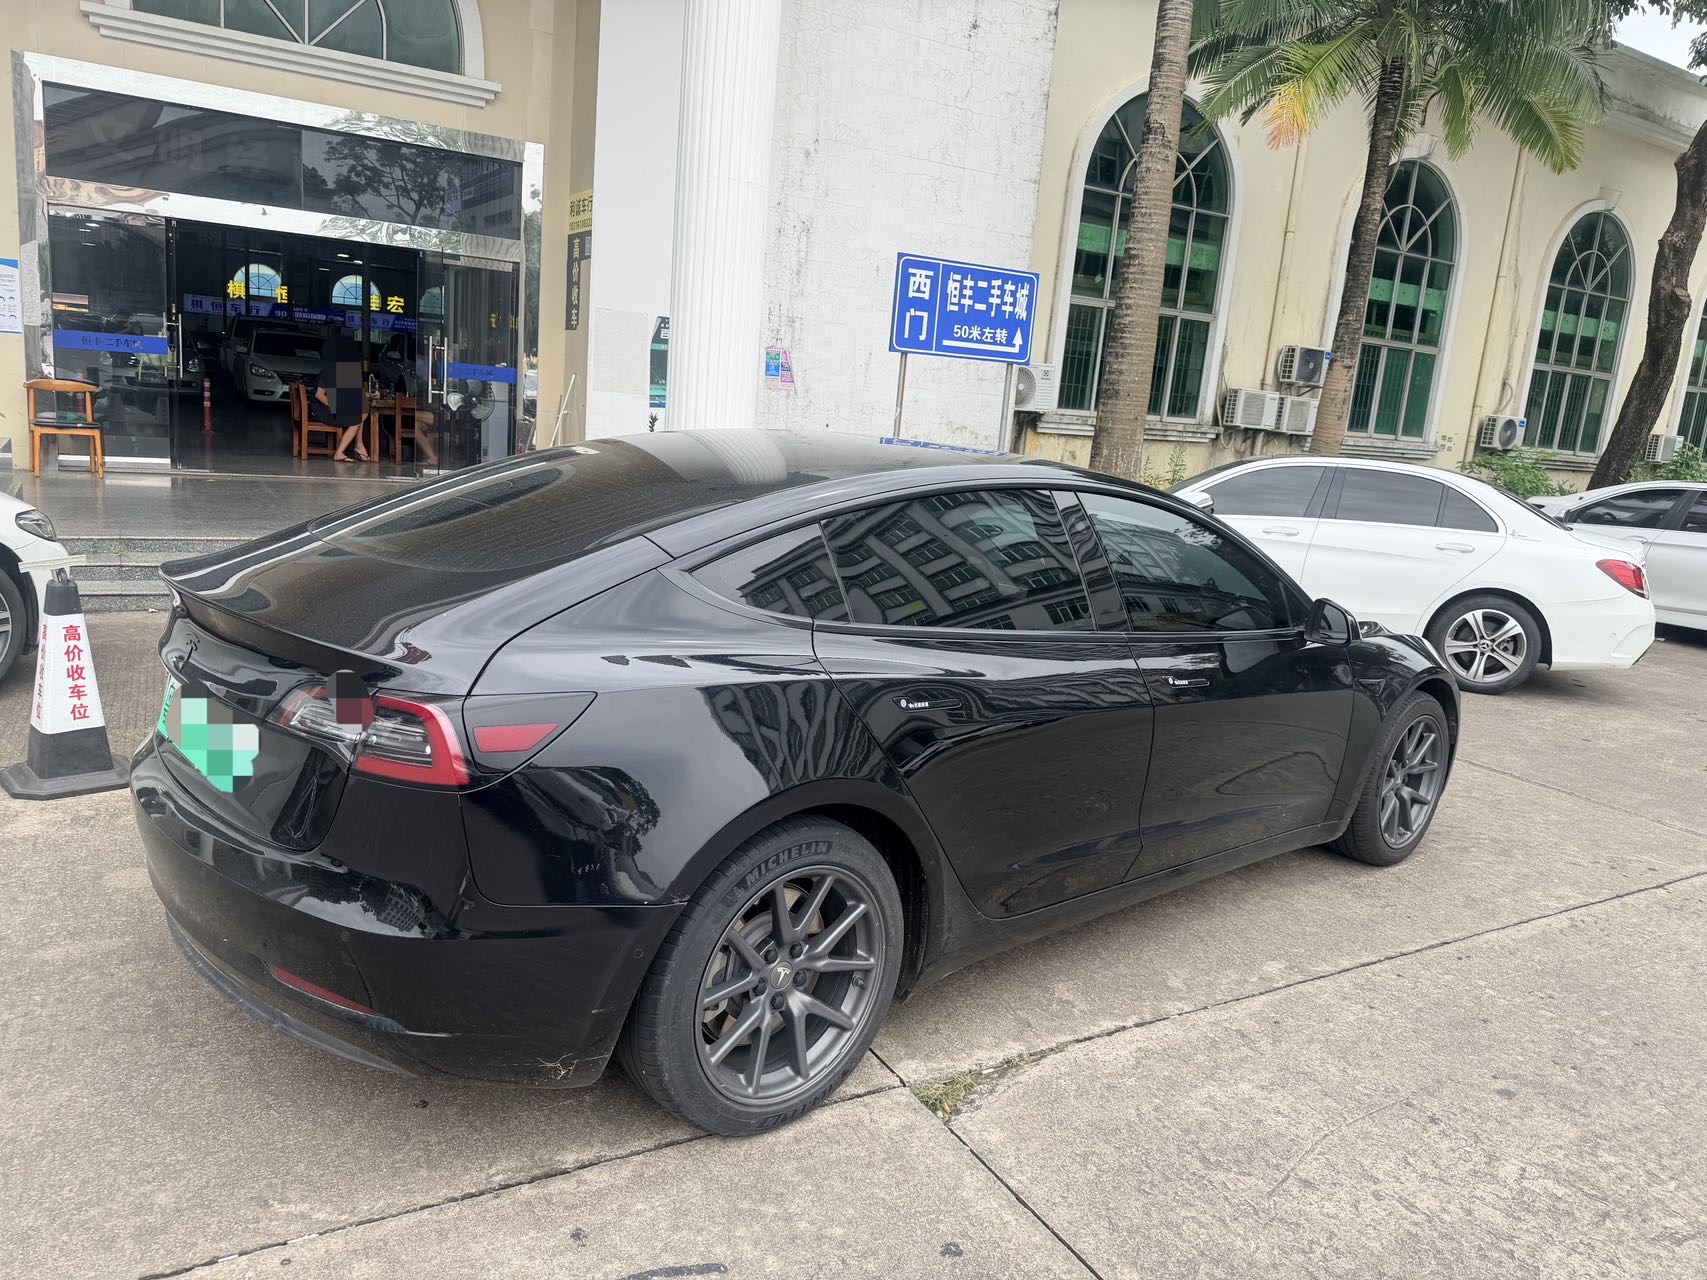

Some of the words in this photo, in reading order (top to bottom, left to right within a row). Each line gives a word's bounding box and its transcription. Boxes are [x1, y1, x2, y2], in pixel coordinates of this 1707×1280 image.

[571, 237, 581, 329] 高价收车
[904, 267, 935, 341] 西门
[946, 271, 1030, 321] 恒丰二手车城
[953, 324, 1008, 345] 50米左转
[62, 624, 90, 721] 高价收车位
[745, 841, 827, 885] MICHELIN
